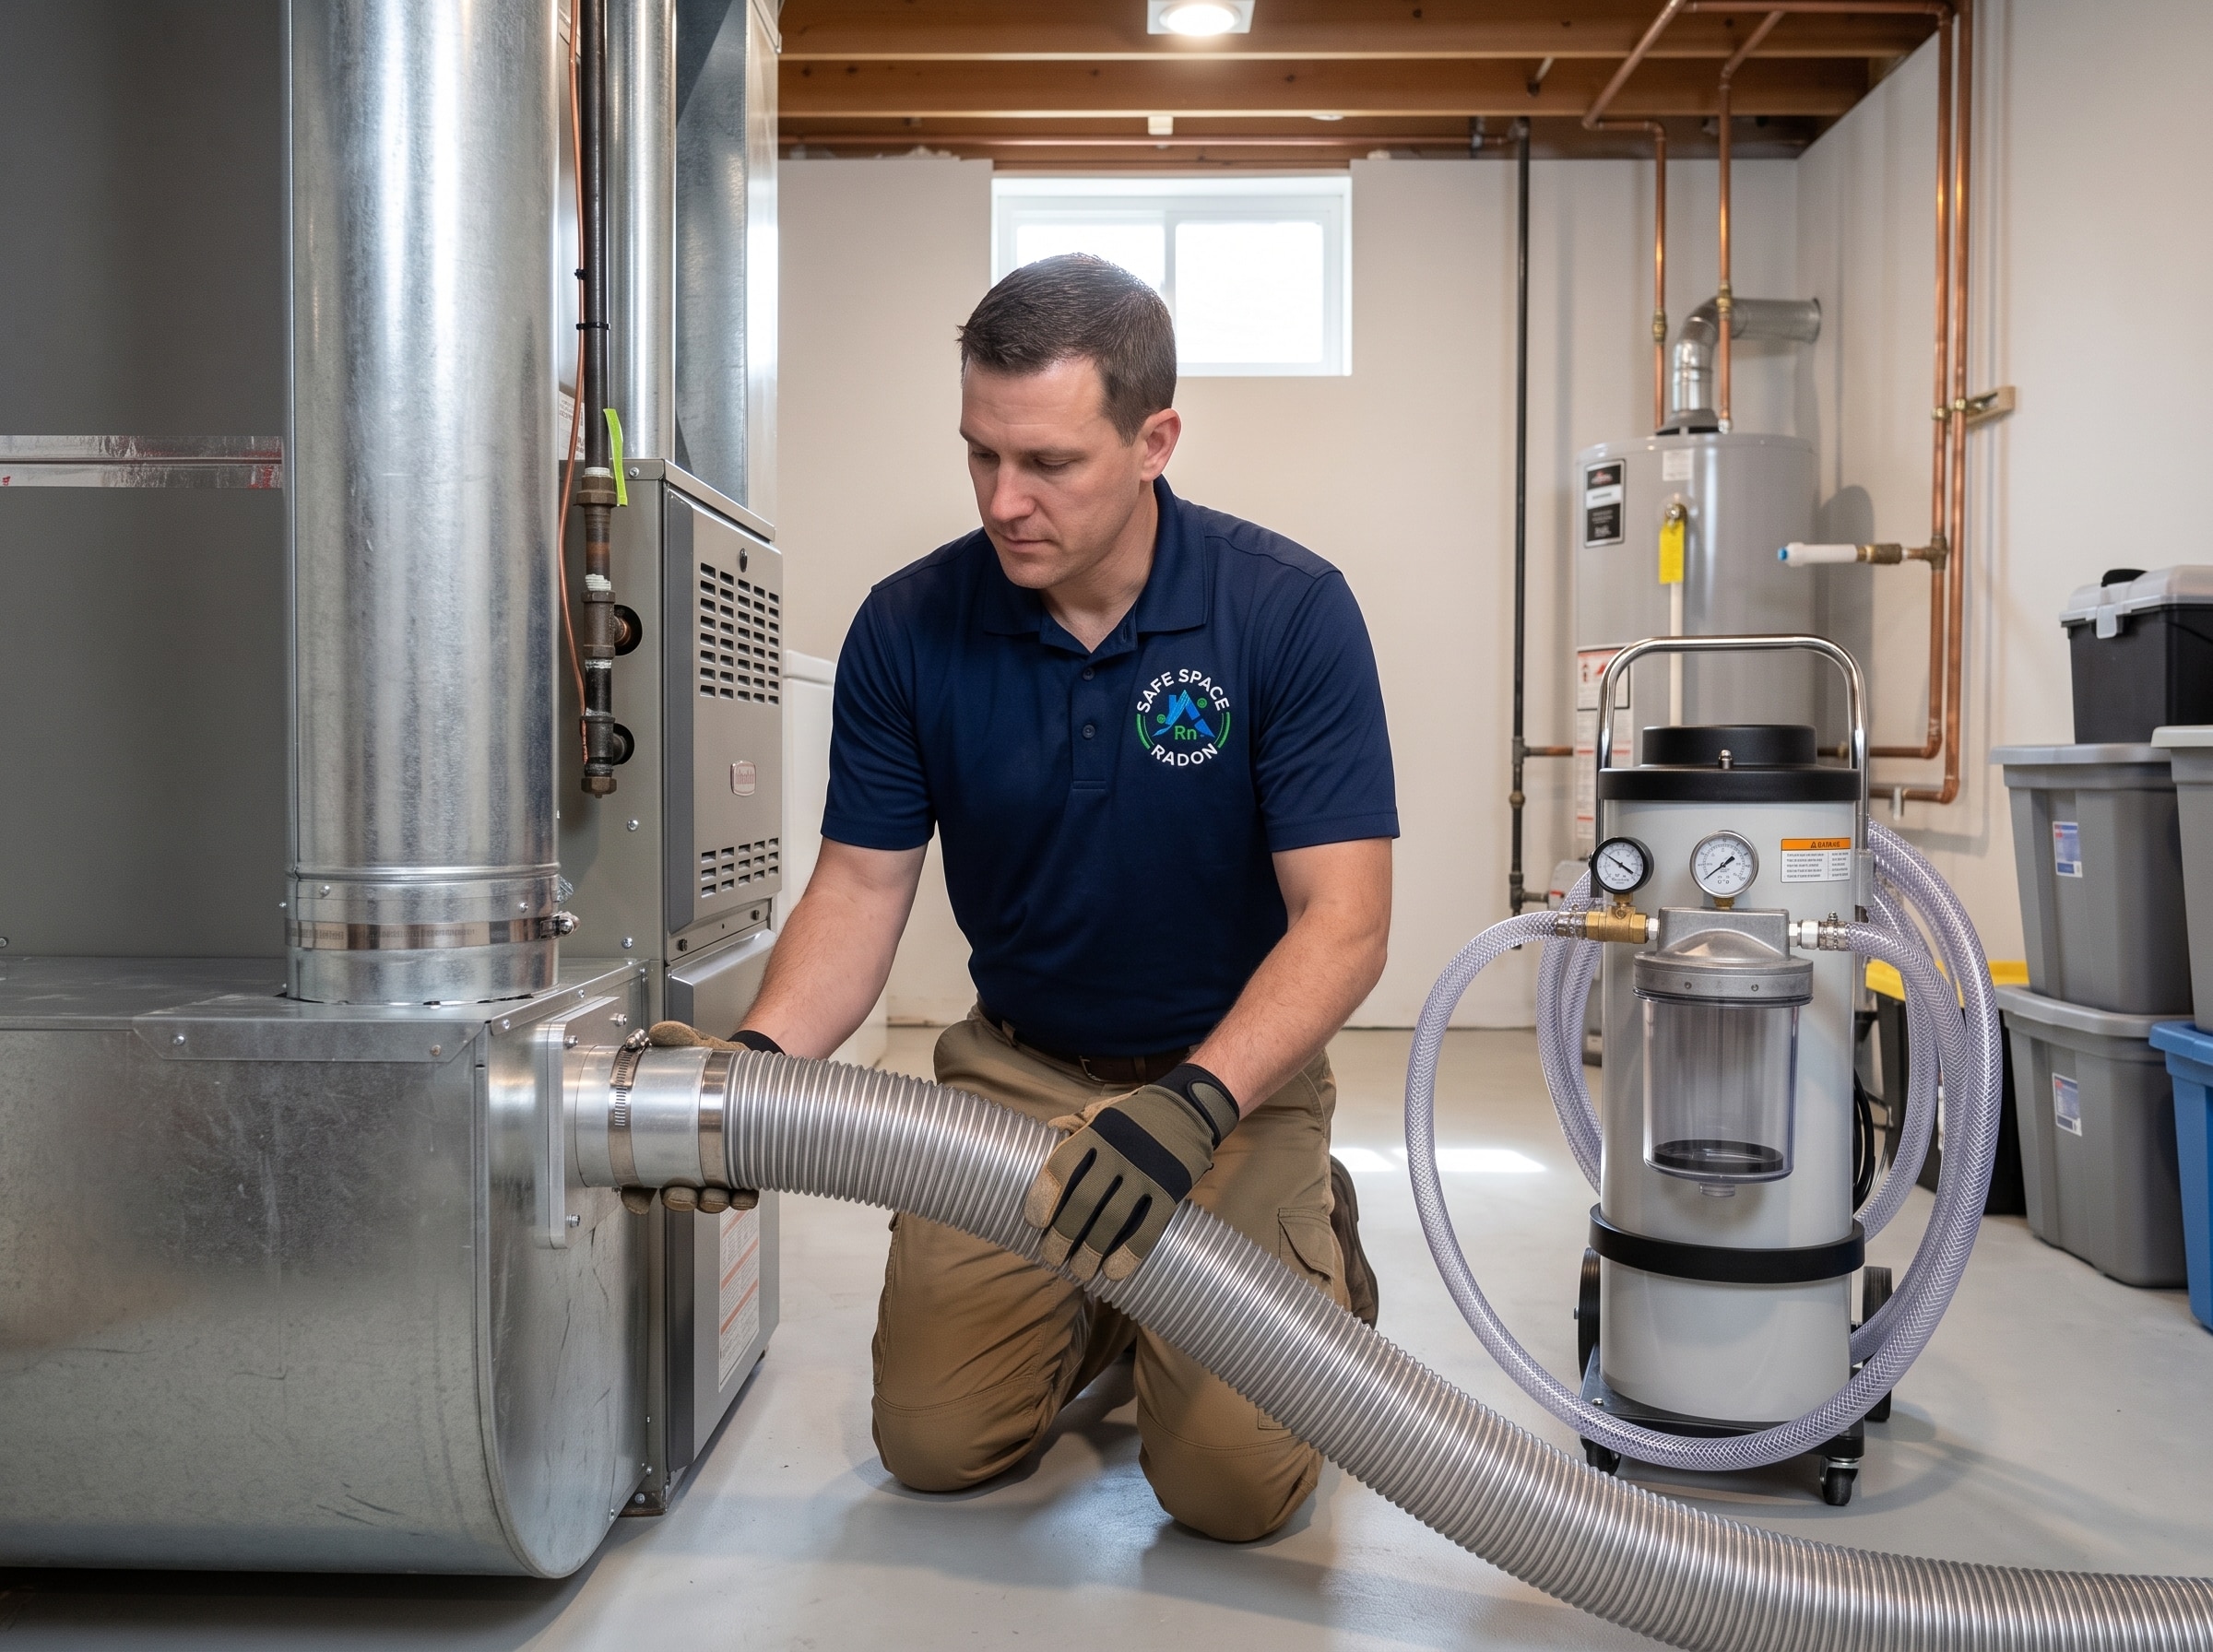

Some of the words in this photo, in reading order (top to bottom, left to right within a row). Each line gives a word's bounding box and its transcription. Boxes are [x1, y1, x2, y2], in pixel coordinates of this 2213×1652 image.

[1136, 671, 1175, 714] SAFE
[1178, 668, 1230, 712] SPACE
[1174, 725, 1197, 740] Rn
[1151, 742, 1218, 767] RADON
